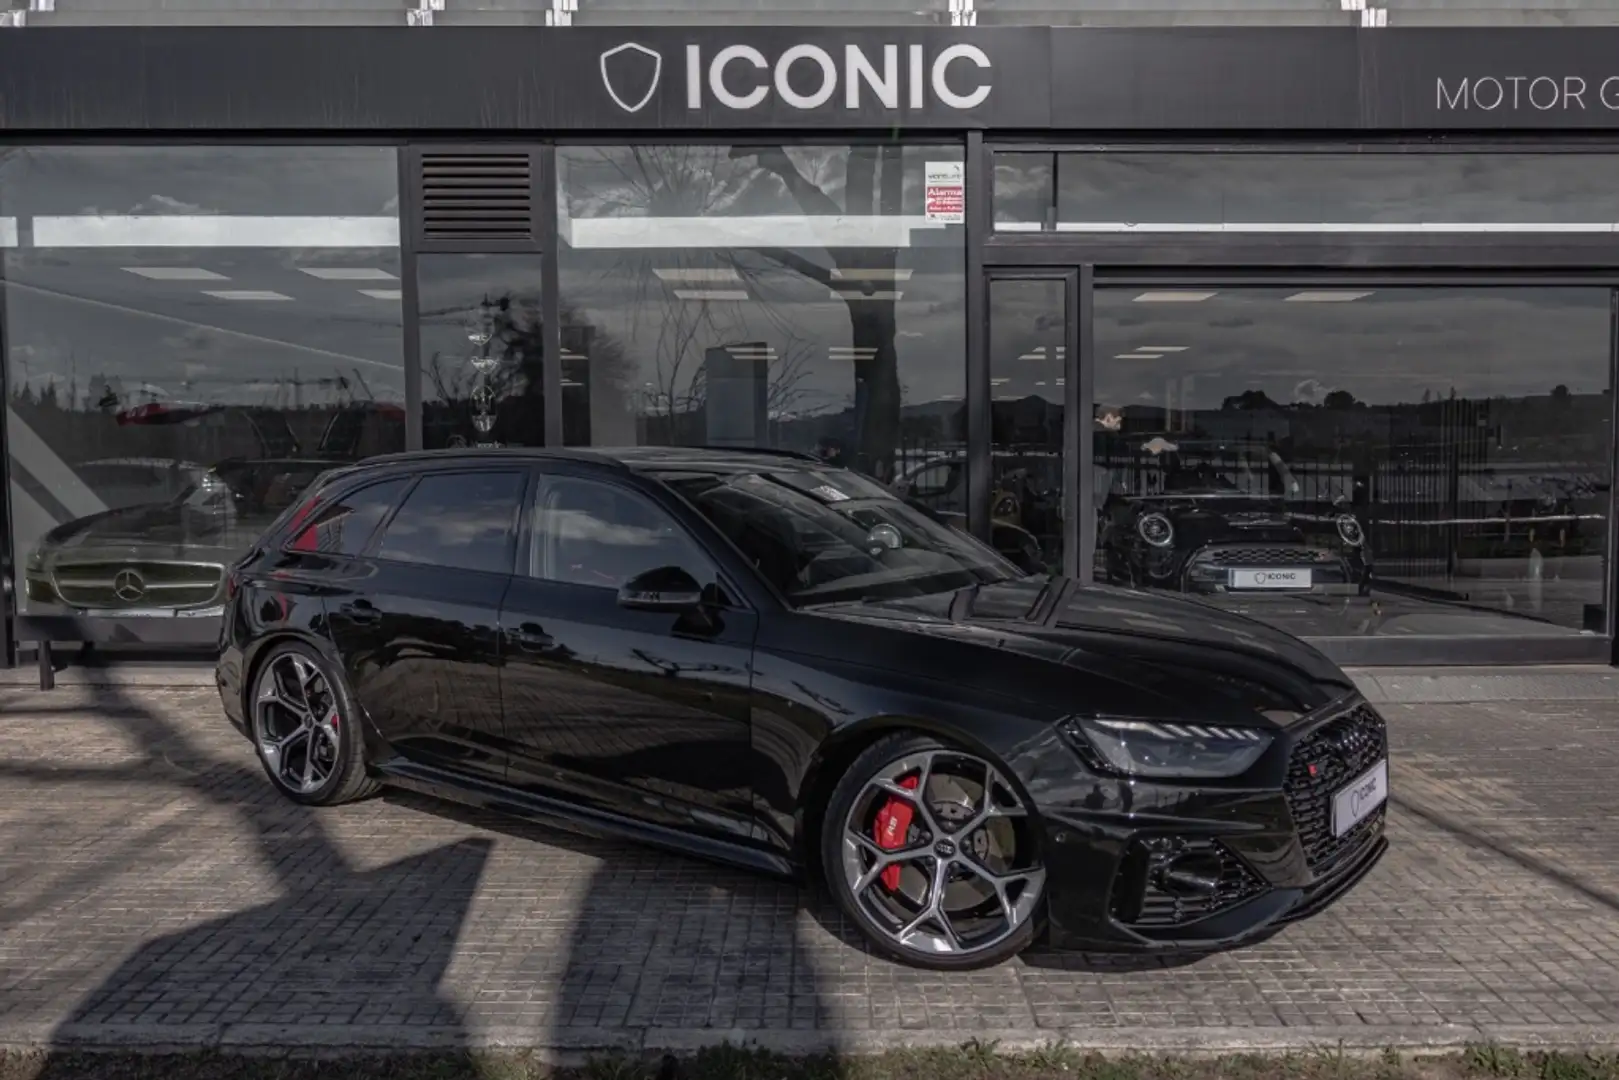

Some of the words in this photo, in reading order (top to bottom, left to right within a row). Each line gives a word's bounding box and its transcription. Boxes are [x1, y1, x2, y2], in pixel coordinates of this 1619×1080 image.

[686, 44, 992, 109] ICONIC
[1437, 76, 1586, 110] MOTOR
[1268, 572, 1297, 580] ICONIC
